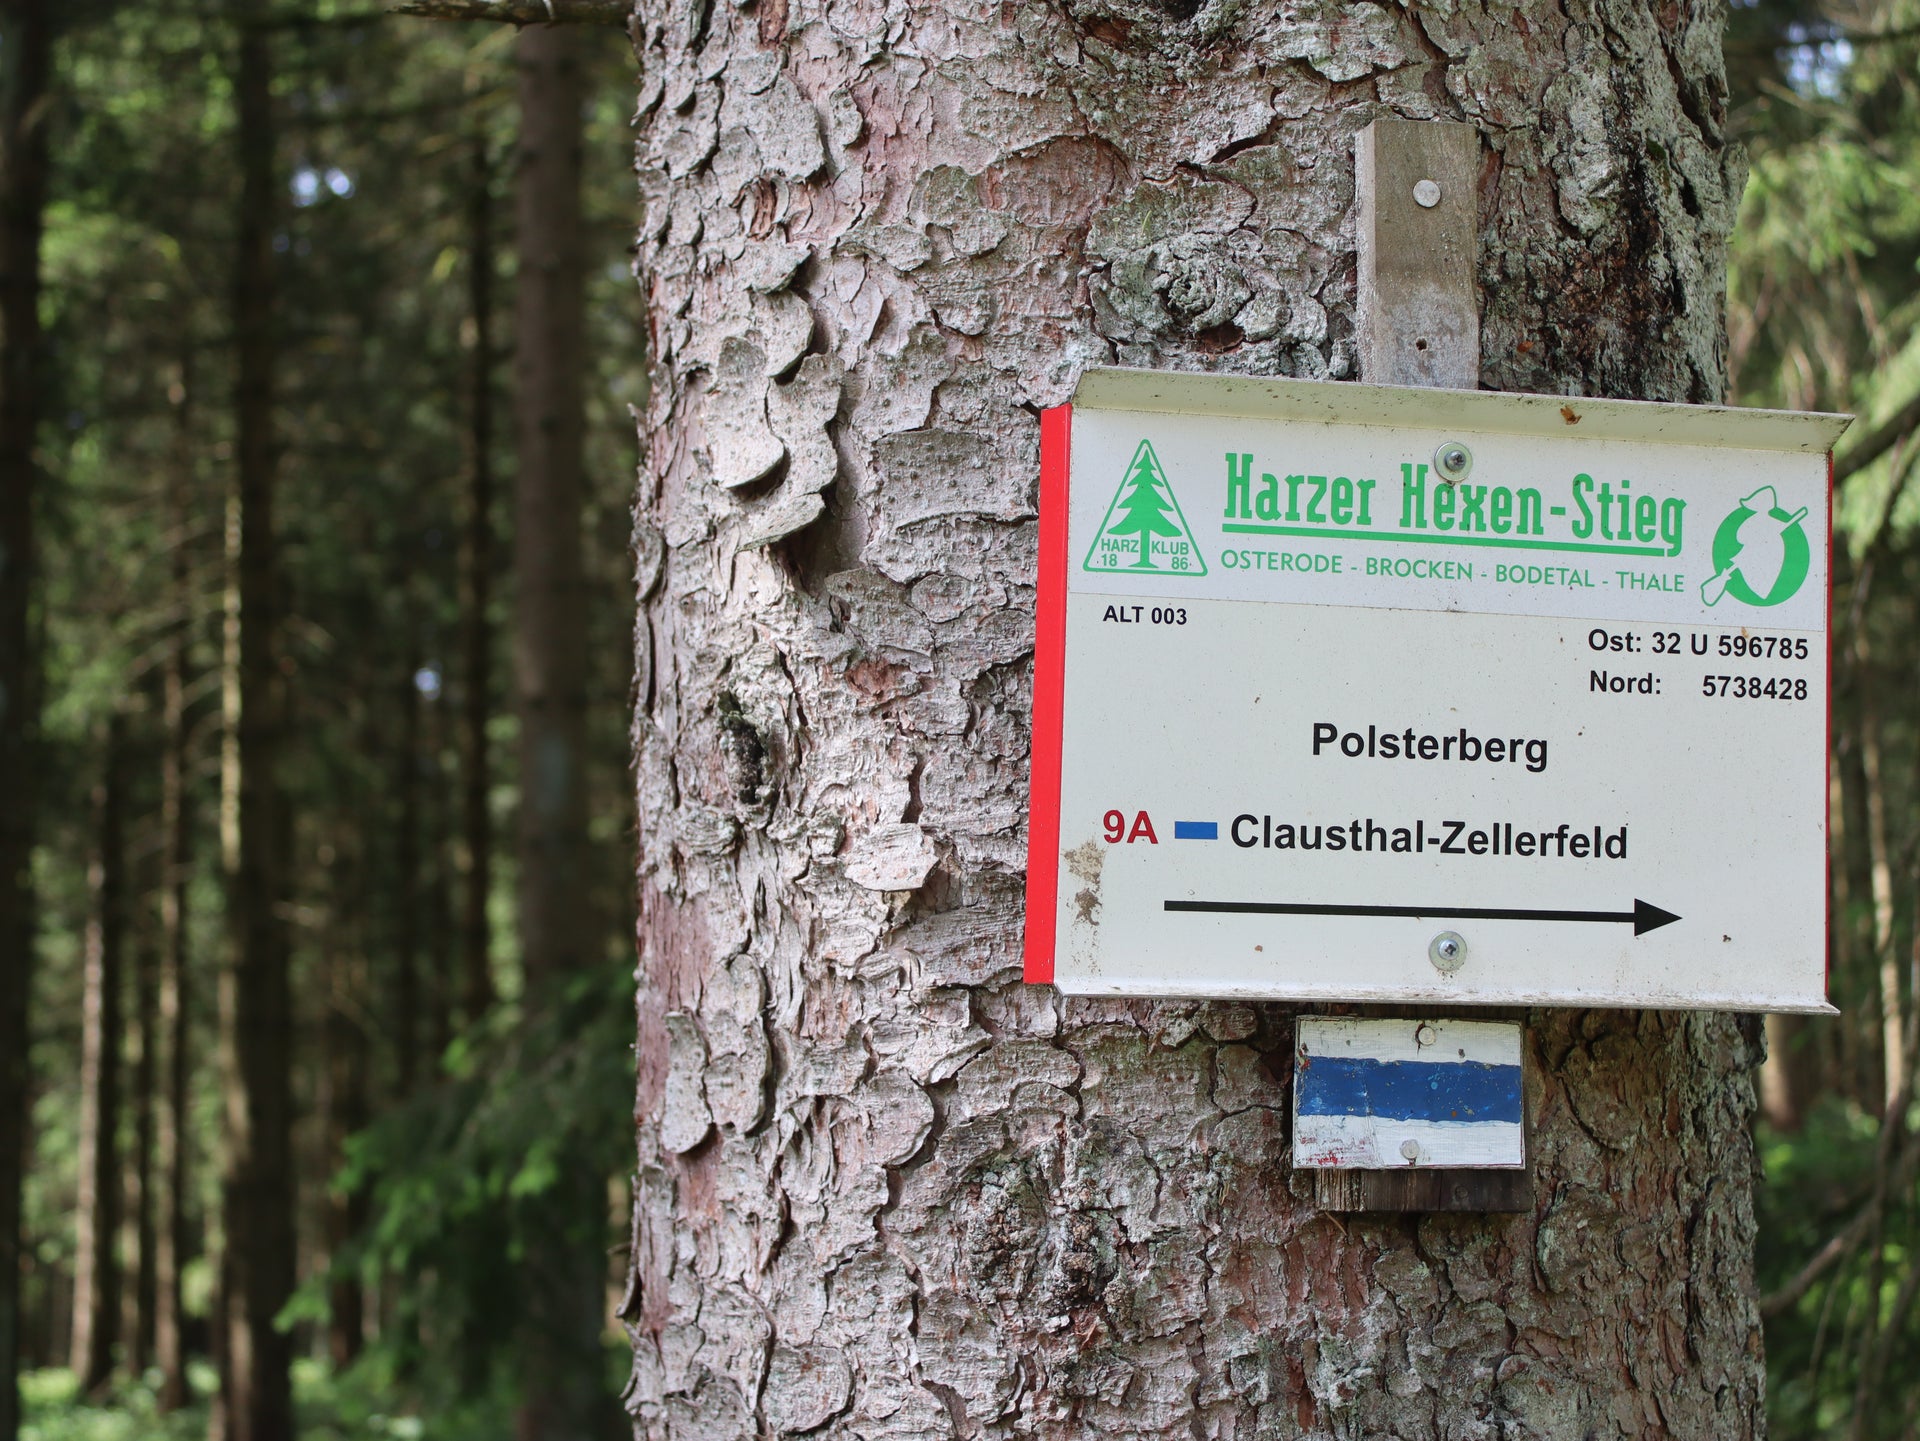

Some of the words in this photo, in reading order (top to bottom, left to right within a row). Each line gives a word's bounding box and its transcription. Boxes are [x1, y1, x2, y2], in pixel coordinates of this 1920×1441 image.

[1223, 452, 1376, 526] Harzer
[1398, 462, 1687, 557] Hexen-Stieg
[1101, 538, 1139, 553] HARZ
[1151, 541, 1189, 555] KLUB
[1101, 553, 1118, 567] 18
[1171, 557, 1189, 571] 86
[1221, 549, 1343, 574] OSTERODE
[1366, 557, 1474, 581] BROCKEN
[1496, 564, 1595, 588] BODETAL
[1616, 571, 1685, 593] THALE
[1102, 605, 1145, 623] ALT
[1151, 607, 1188, 626] 003
[1588, 628, 1641, 653] Ost:
[1651, 631, 1682, 655] 32
[1691, 633, 1709, 656] U
[1718, 634, 1809, 660] 596785
[1590, 670, 1661, 695] Nord:
[1702, 675, 1808, 701] 5738428
[1312, 722, 1548, 773] Polsterberg
[1103, 809, 1159, 845] 9A
[1230, 813, 1627, 858] Clausthal-Zellerfeld
